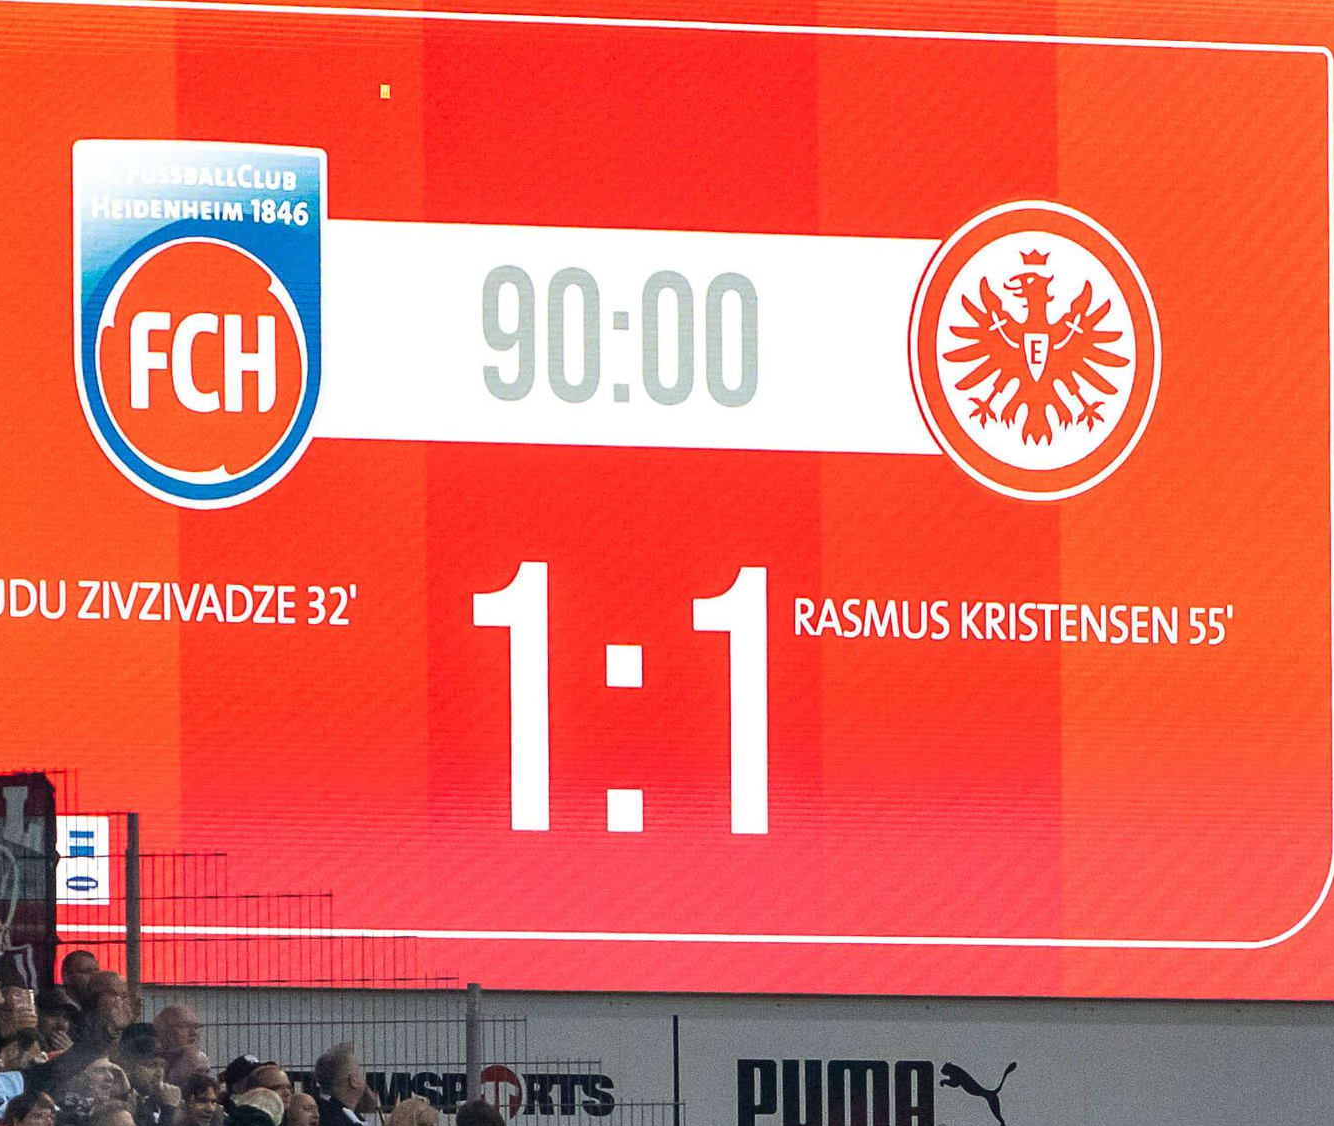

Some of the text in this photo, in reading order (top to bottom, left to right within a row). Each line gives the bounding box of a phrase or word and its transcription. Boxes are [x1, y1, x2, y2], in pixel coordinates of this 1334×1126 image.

[250, 198, 309, 226] 1846
[129, 311, 277, 414] FCH
[482, 265, 759, 408] 90:00
[77, 580, 296, 625] ZIVZIVADZE
[307, 583, 358, 625] 32'
[794, 597, 1234, 646] RASMUS KRISTENSEN 55'
[473, 561, 769, 835] 1:1
